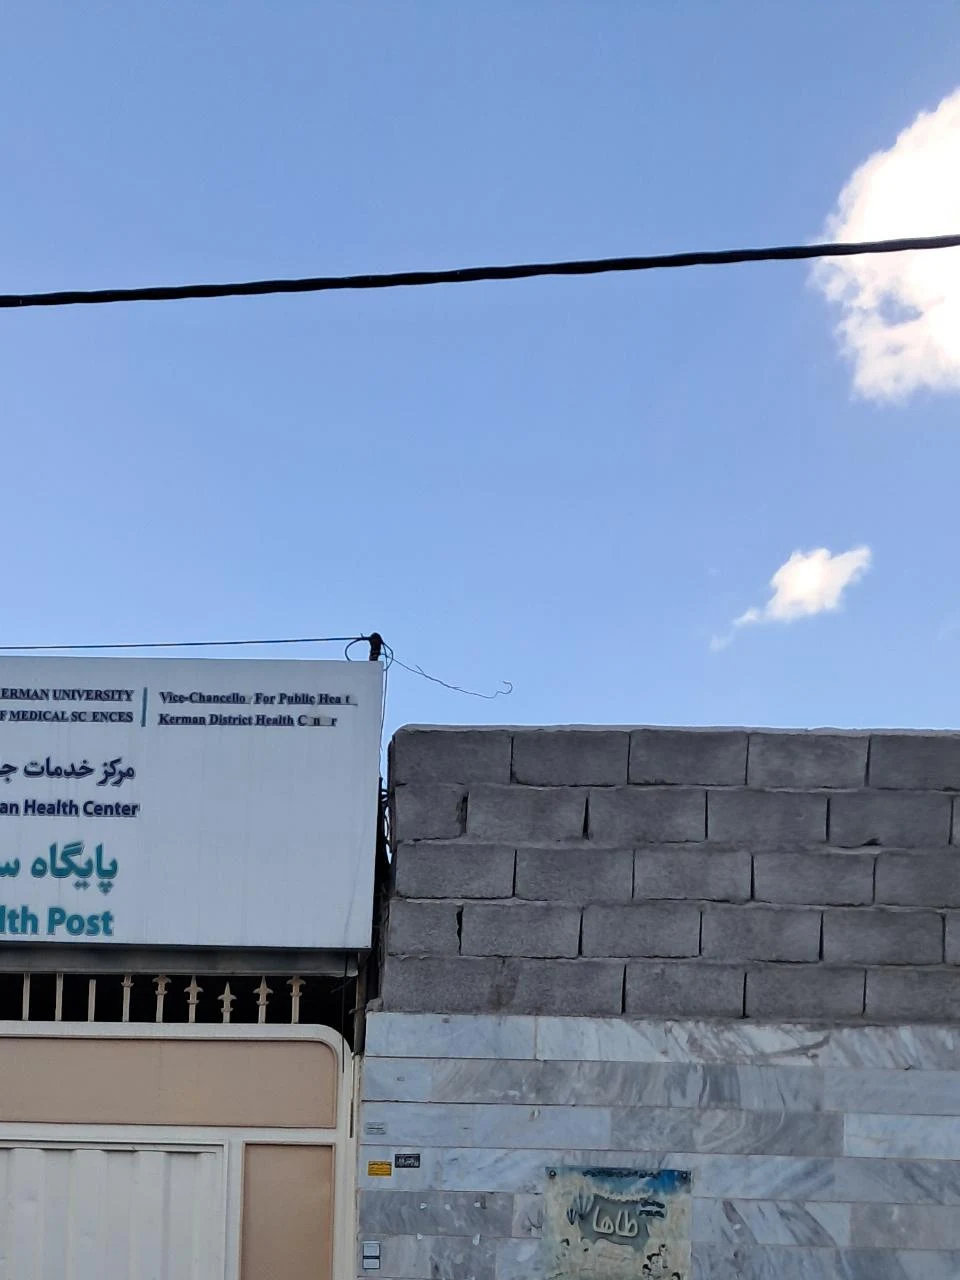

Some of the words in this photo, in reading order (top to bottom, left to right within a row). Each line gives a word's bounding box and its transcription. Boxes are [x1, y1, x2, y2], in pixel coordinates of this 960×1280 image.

[52, 689, 134, 701] UNIVERSITY
[159, 691, 248, 704] Vice-Chancello
[254, 692, 274, 704] For
[277, 693, 316, 705] Public
[317, 693, 357, 705] Heat
[8, 710, 69, 722] MEDICAL
[71, 711, 134, 723] SCENCES
[158, 713, 206, 726] Kerman
[208, 714, 253, 726] District
[254, 714, 294, 726] Health
[297, 715, 337, 726] Cnr
[23, 757, 95, 779] خدمات
[96, 757, 136, 787] مرکز
[24, 799, 80, 817] Health
[83, 800, 138, 817] Center
[30, 840, 118, 895] پایگاه
[46, 906, 114, 936] Post
[592, 1205, 638, 1238] طاها
